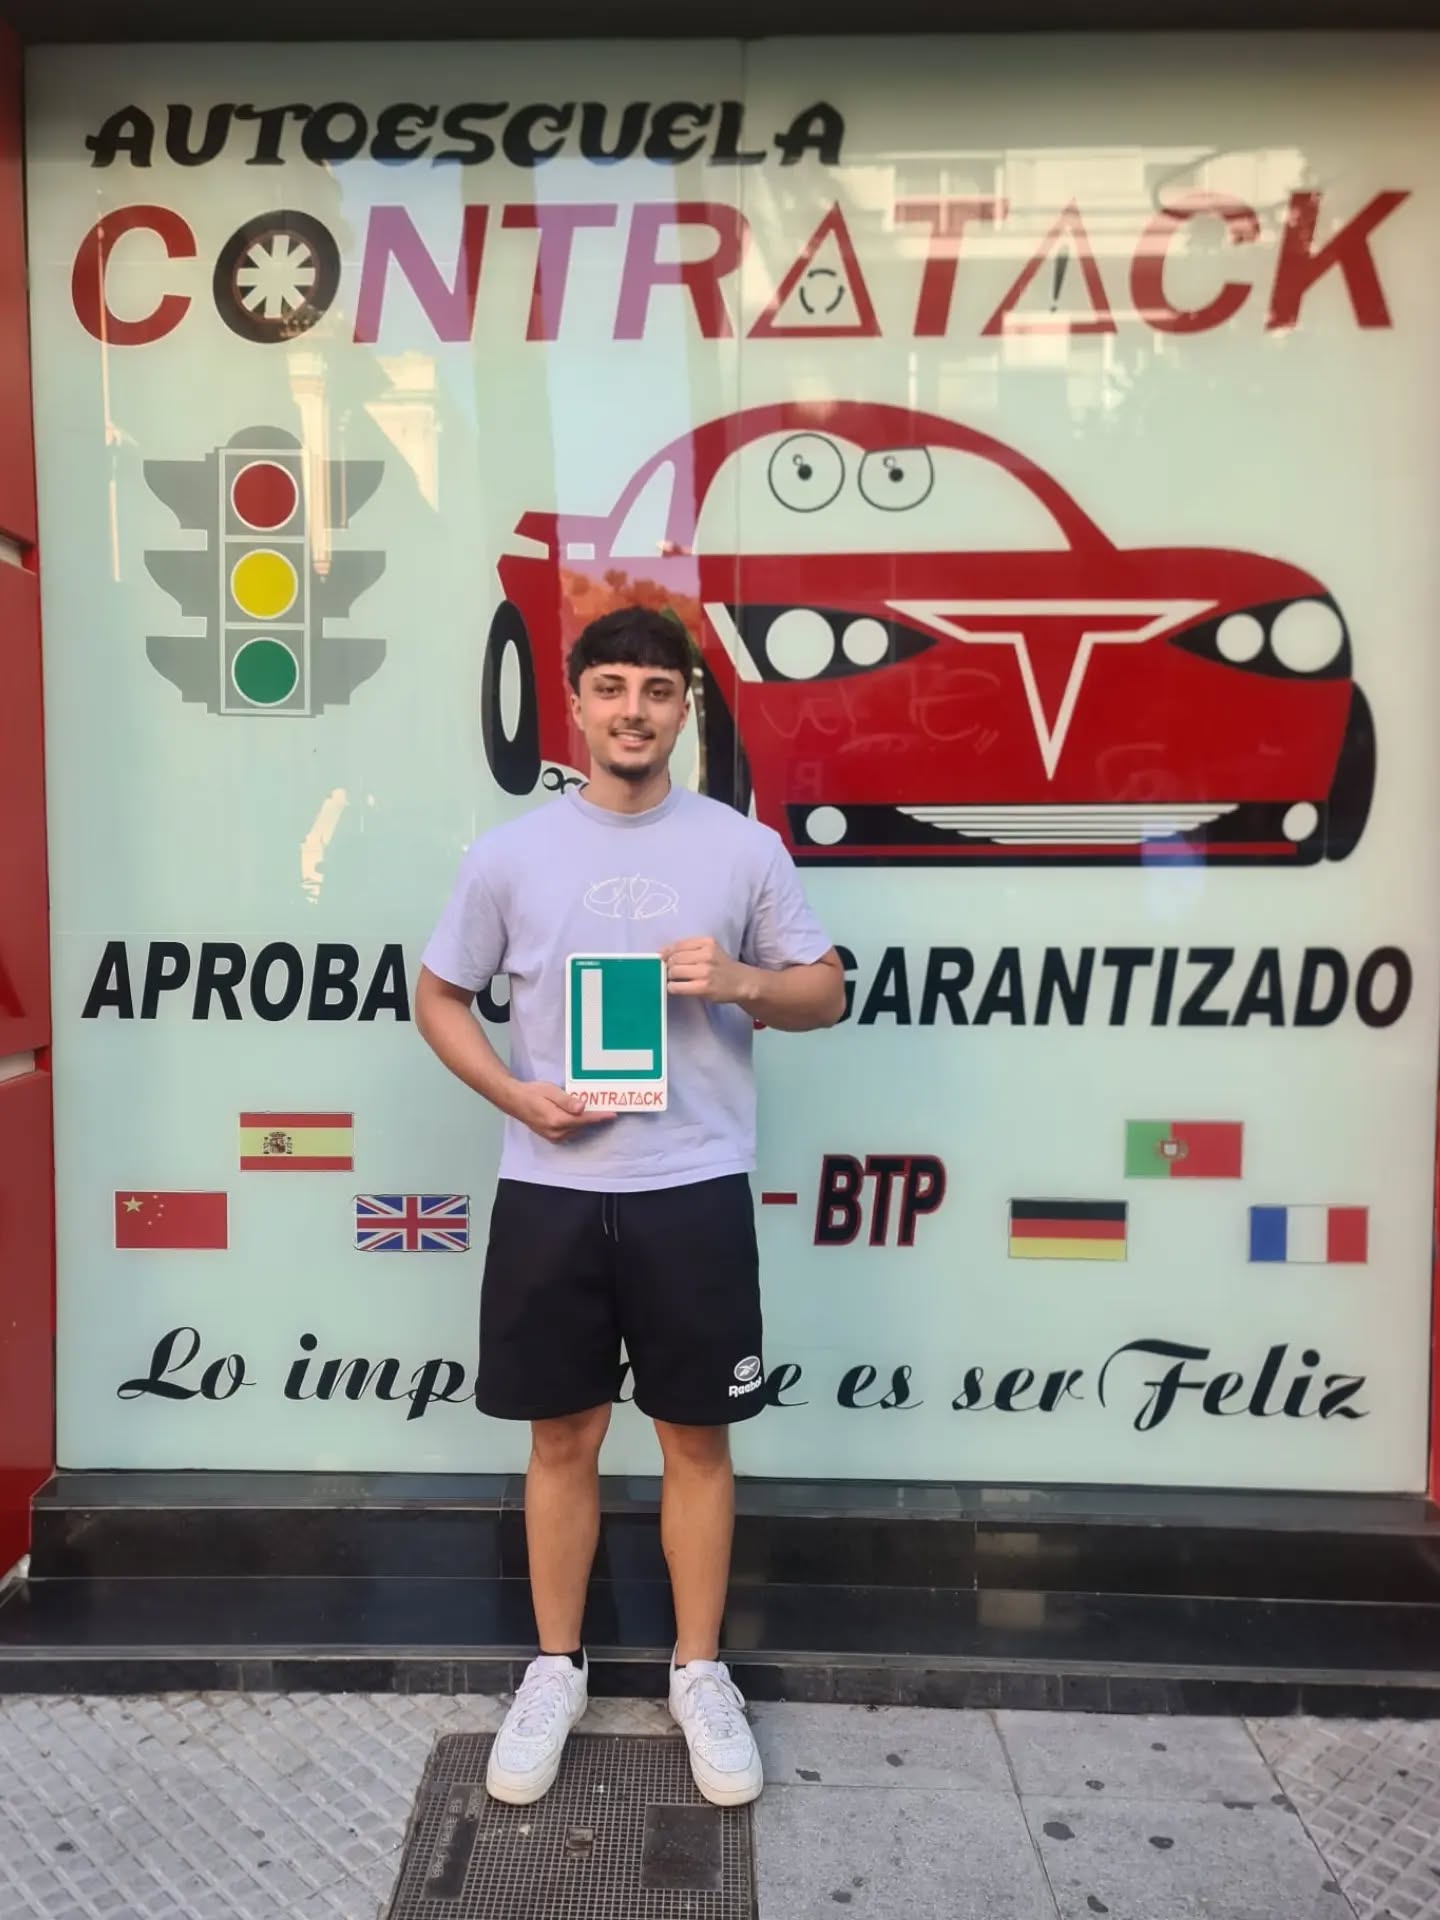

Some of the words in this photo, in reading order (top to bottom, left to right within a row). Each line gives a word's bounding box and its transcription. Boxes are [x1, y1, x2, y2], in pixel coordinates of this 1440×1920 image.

[85, 101, 845, 168] AUTOESCUELA
[71, 188, 1413, 347] CONTRATACK
[581, 968, 654, 1071] L
[813, 1154, 947, 1247] BTP
[117, 1326, 257, 1400] Lo
[836, 1362, 924, 1412] es
[952, 1365, 1086, 1412] ser
[1098, 1338, 1371, 1432] Feliz
